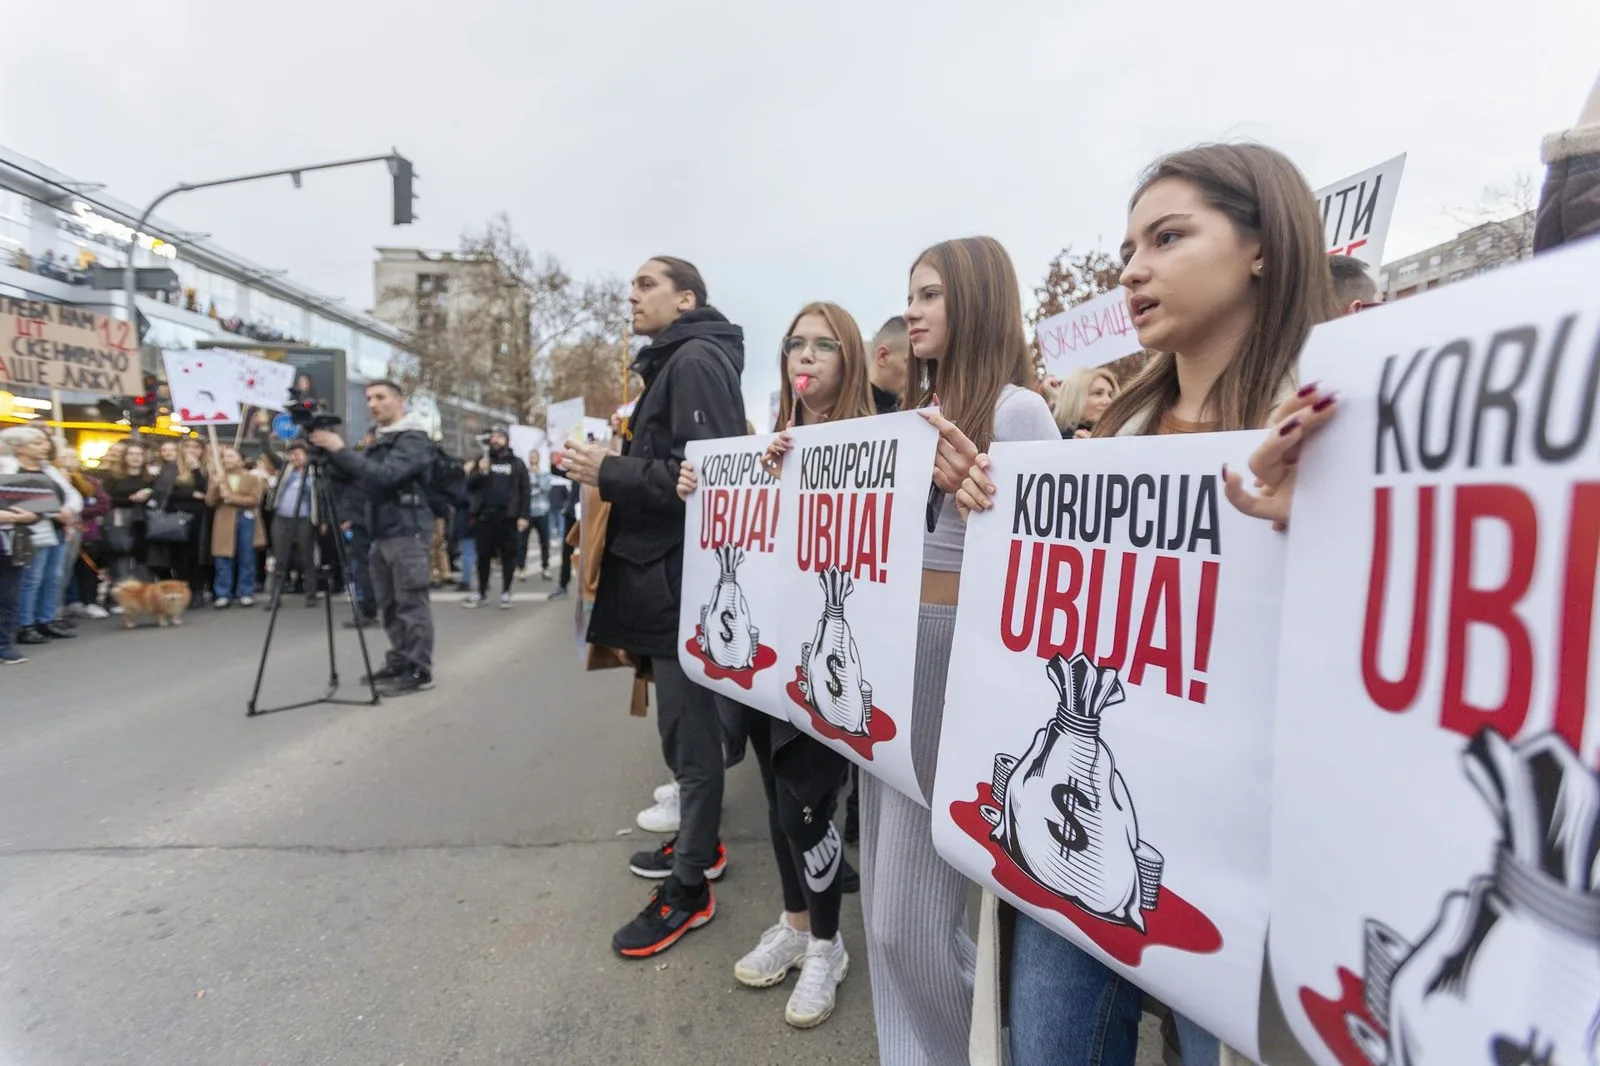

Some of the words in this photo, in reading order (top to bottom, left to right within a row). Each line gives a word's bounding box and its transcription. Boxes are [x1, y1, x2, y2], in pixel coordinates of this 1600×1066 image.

[1316, 173, 1383, 248] ТИ
[800, 438, 898, 490] KORUPCIJA
[700, 487, 780, 553] UBIJA!
[797, 492, 894, 584] UBIJA!
[1012, 473, 1221, 556] KORUPCIJA
[1000, 539, 1221, 705] UBIJA!
